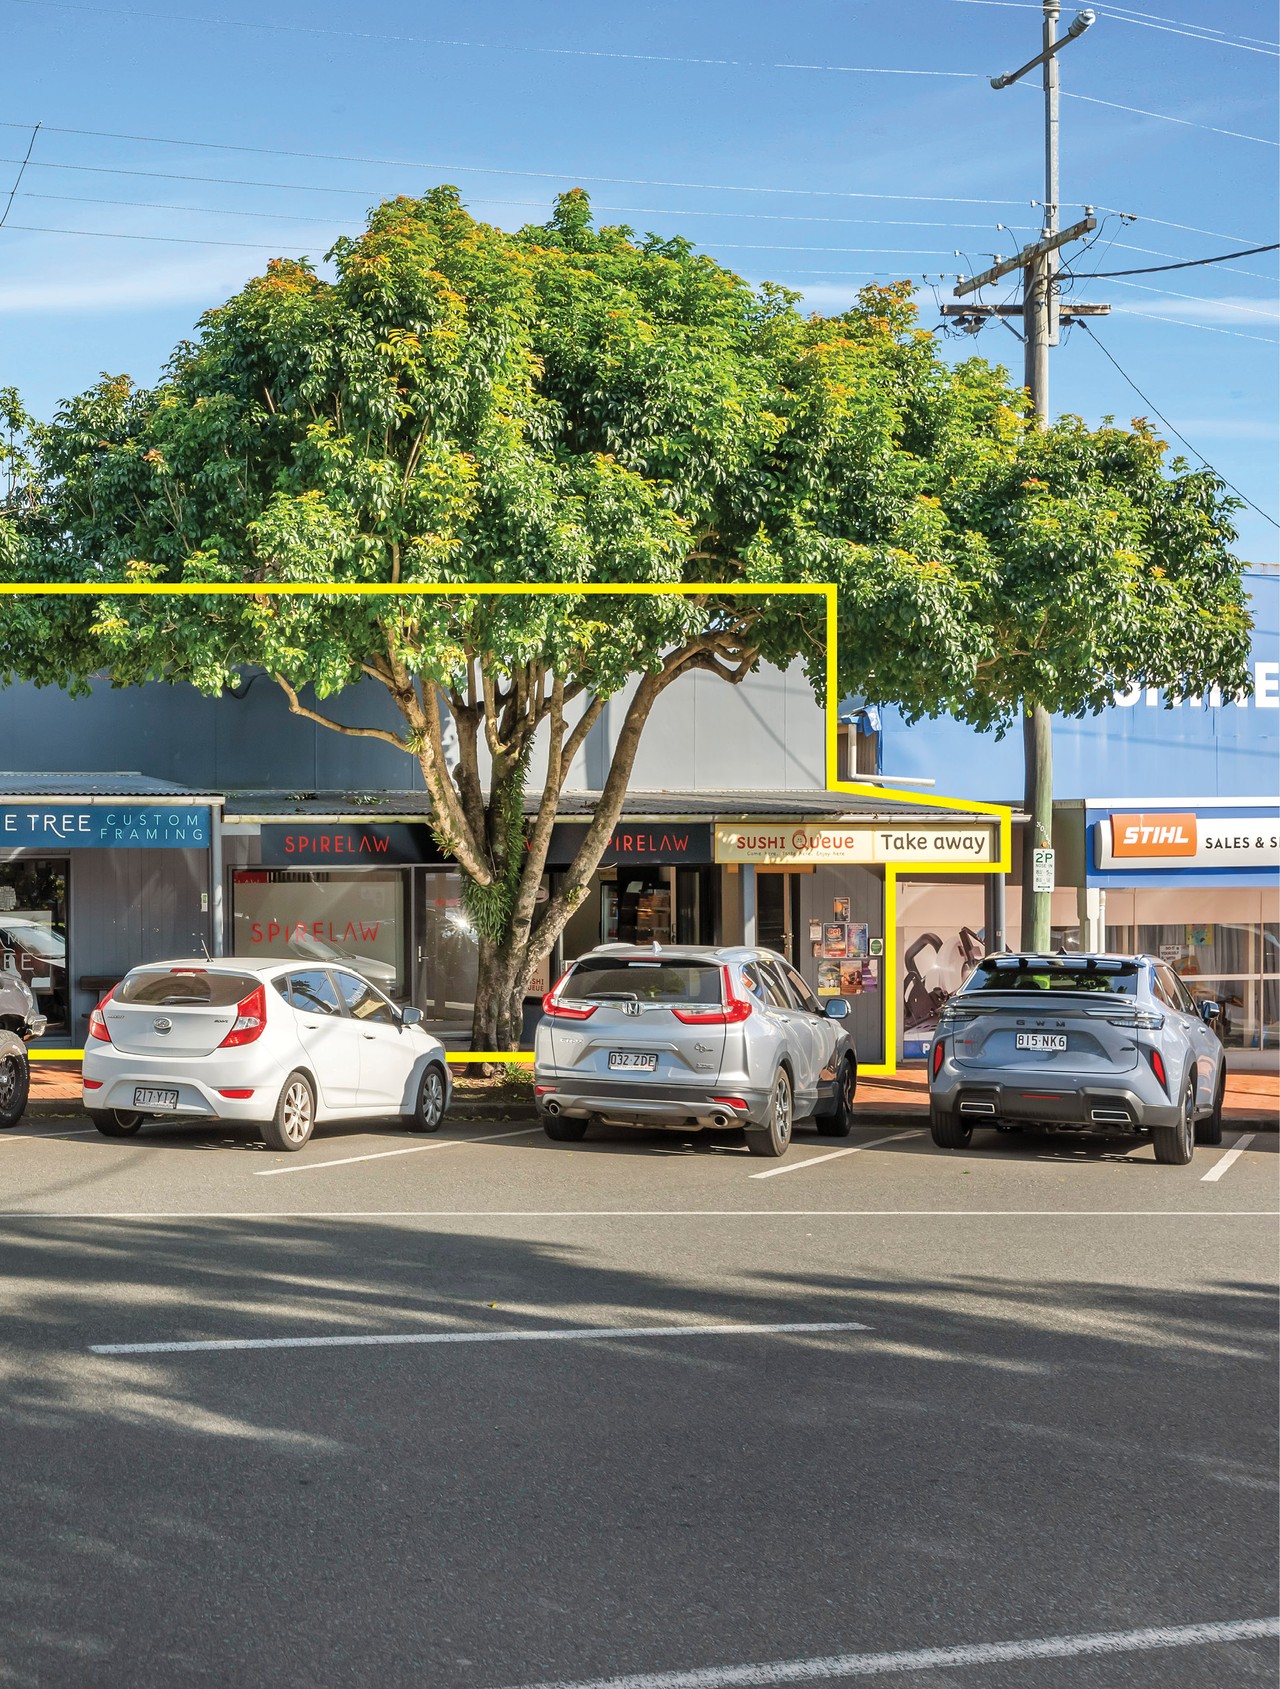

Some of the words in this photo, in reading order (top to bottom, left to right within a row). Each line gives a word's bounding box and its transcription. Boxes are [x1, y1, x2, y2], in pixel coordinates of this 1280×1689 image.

[27, 814, 91, 838] TREE
[106, 814, 199, 826] CUSTOM
[100, 828, 203, 840] FRAMING
[1123, 827, 1189, 844] STIHL
[285, 835, 390, 853] SPIRELAW
[737, 836, 786, 849] SUSHI
[881, 833, 927, 850] Take
[934, 836, 985, 854] away
[1205, 837, 1250, 849] SALES
[1255, 837, 1265, 848] &
[1270, 837, 1280, 848] S
[1036, 853, 1053, 863] 2P
[250, 921, 379, 943] SPIRELAW
